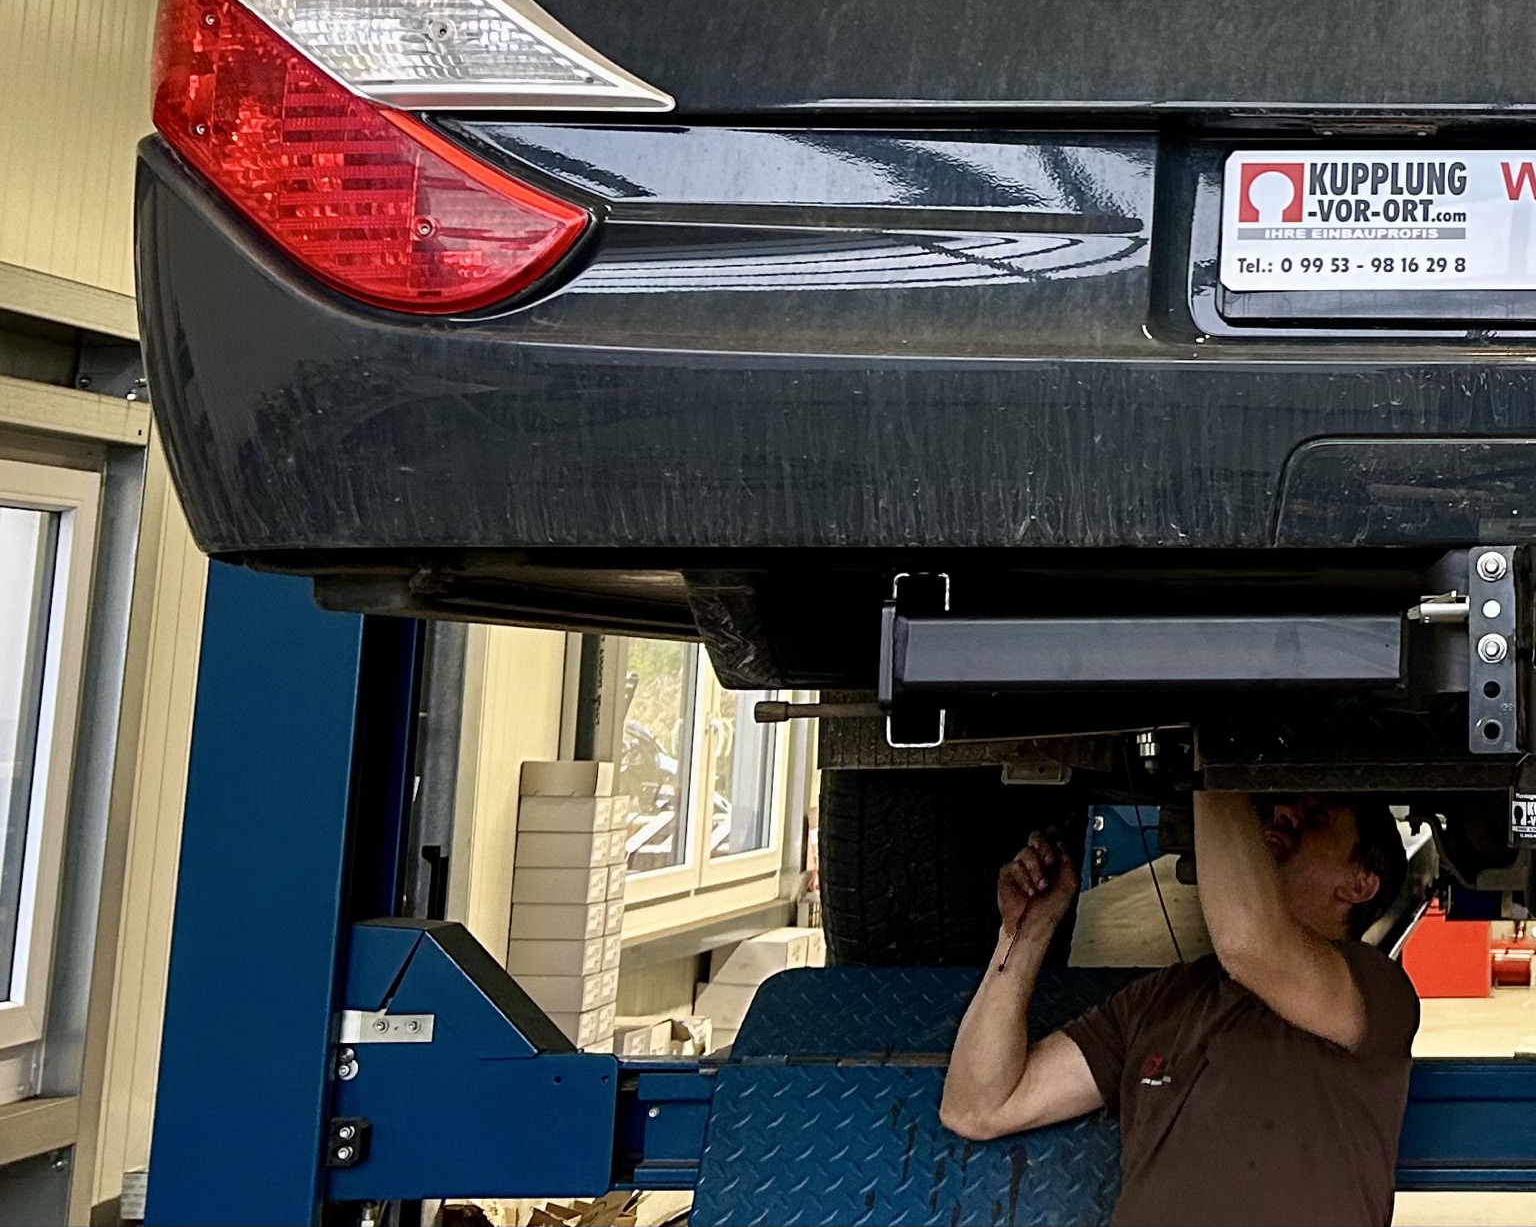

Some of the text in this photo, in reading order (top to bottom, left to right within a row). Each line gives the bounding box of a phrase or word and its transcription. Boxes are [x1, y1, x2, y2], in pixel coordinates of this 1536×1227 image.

[1309, 161, 1467, 196] KUPPLUNG
[1308, 199, 1467, 222] -VOR-ORT.com
[1264, 228, 1439, 239] IHRE EINBAUPROFIS
[1237, 257, 1273, 273] Tel.:
[1281, 257, 1293, 273] 0
[1300, 257, 1324, 273] 99
[1330, 257, 1350, 273] 53
[1371, 257, 1395, 273] 98
[1401, 257, 1419, 273] 16
[1426, 257, 1447, 273] 29
[1454, 257, 1467, 273] 8
